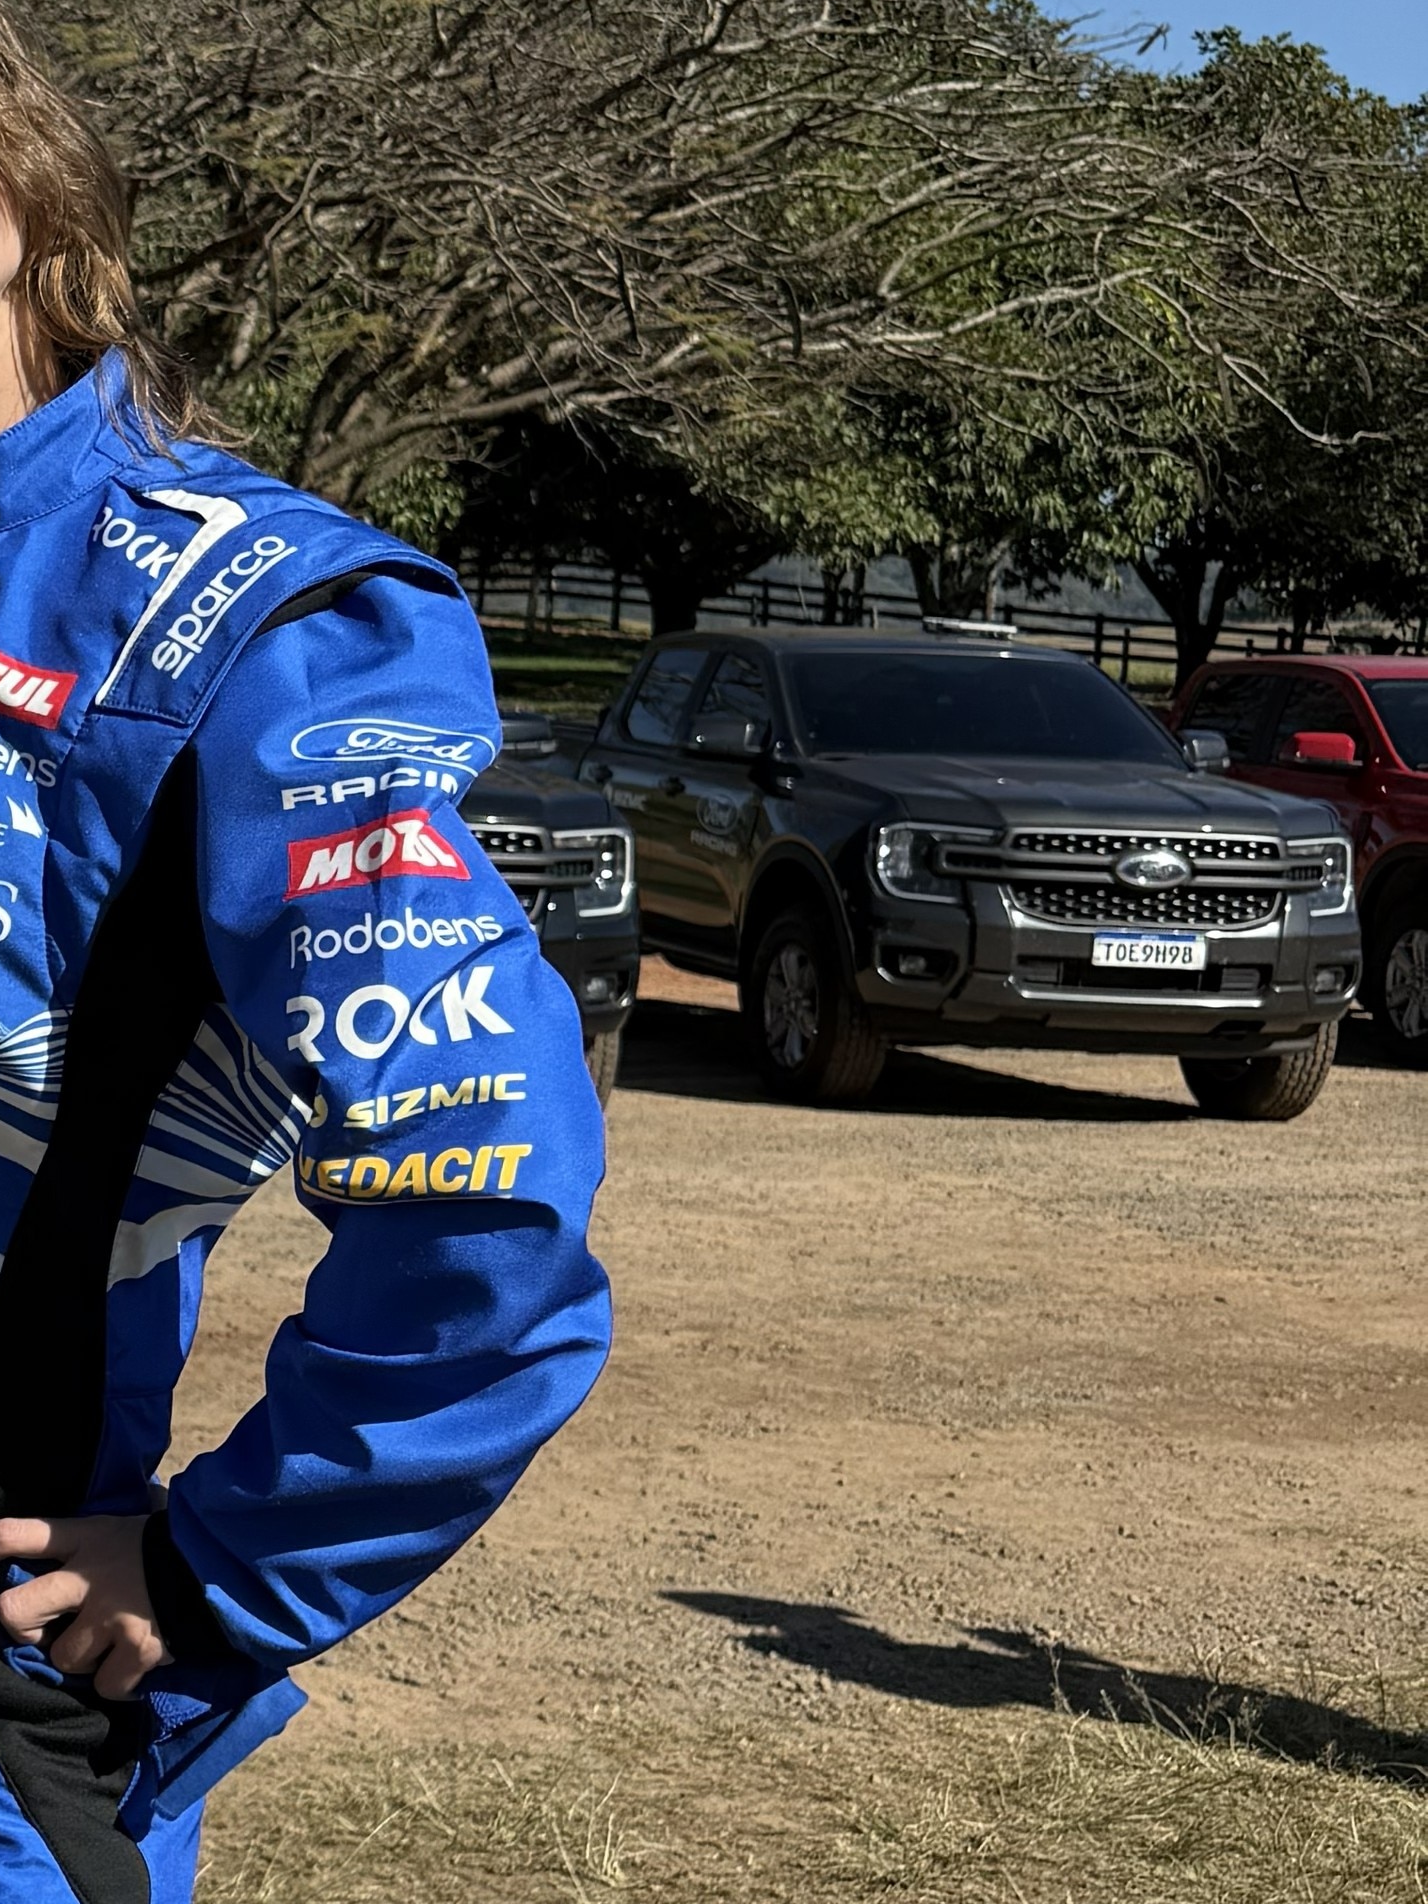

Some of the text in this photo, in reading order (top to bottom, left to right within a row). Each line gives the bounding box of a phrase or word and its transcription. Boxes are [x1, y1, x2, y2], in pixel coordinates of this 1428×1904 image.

[151, 535, 299, 680] sparco
[335, 727, 474, 762] Ford
[290, 907, 504, 970] Rodobens
[1104, 943, 1193, 965] TOE9H98
[285, 965, 516, 1063] ROCK
[343, 1072, 527, 1129] SIZMIC
